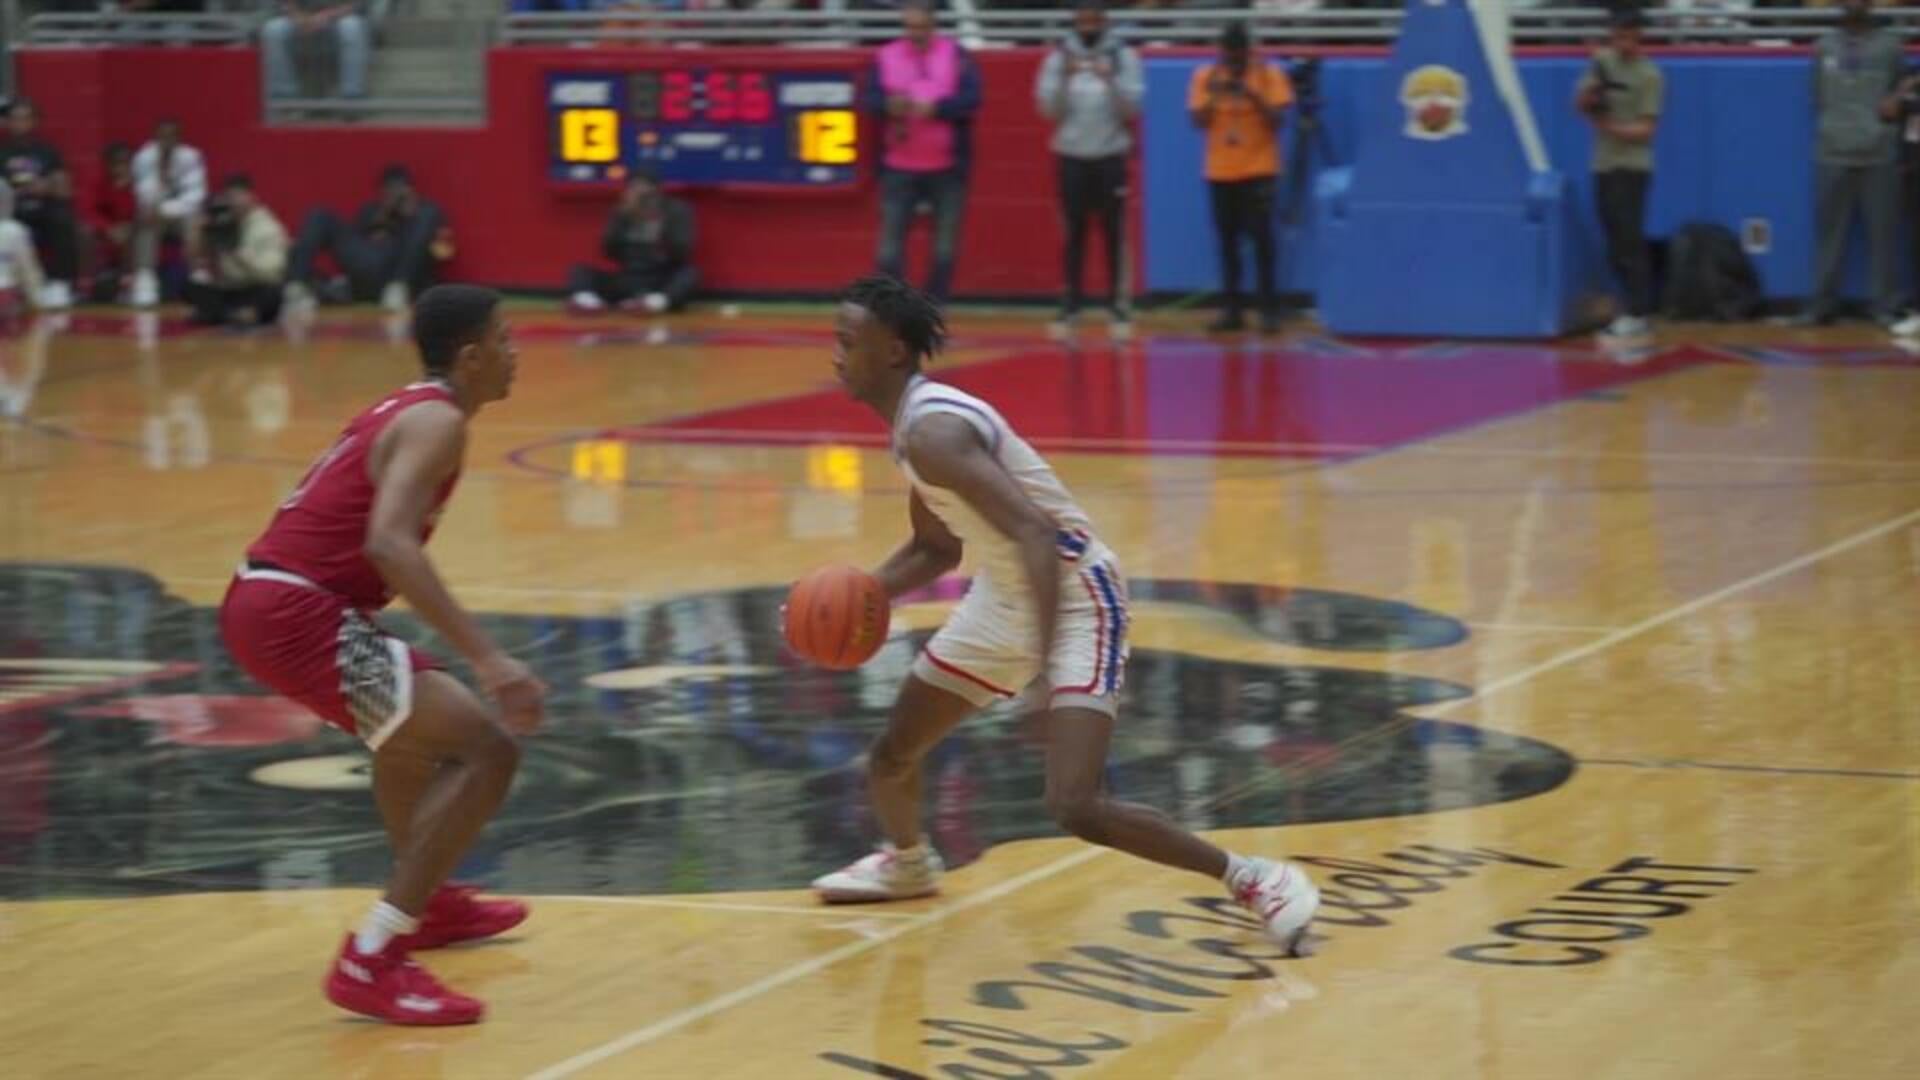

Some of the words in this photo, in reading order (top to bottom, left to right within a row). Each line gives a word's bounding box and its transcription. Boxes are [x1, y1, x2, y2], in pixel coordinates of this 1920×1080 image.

[560, 108, 619, 162] 13
[798, 109, 858, 163] 12
[1449, 856, 1757, 968] COURT
